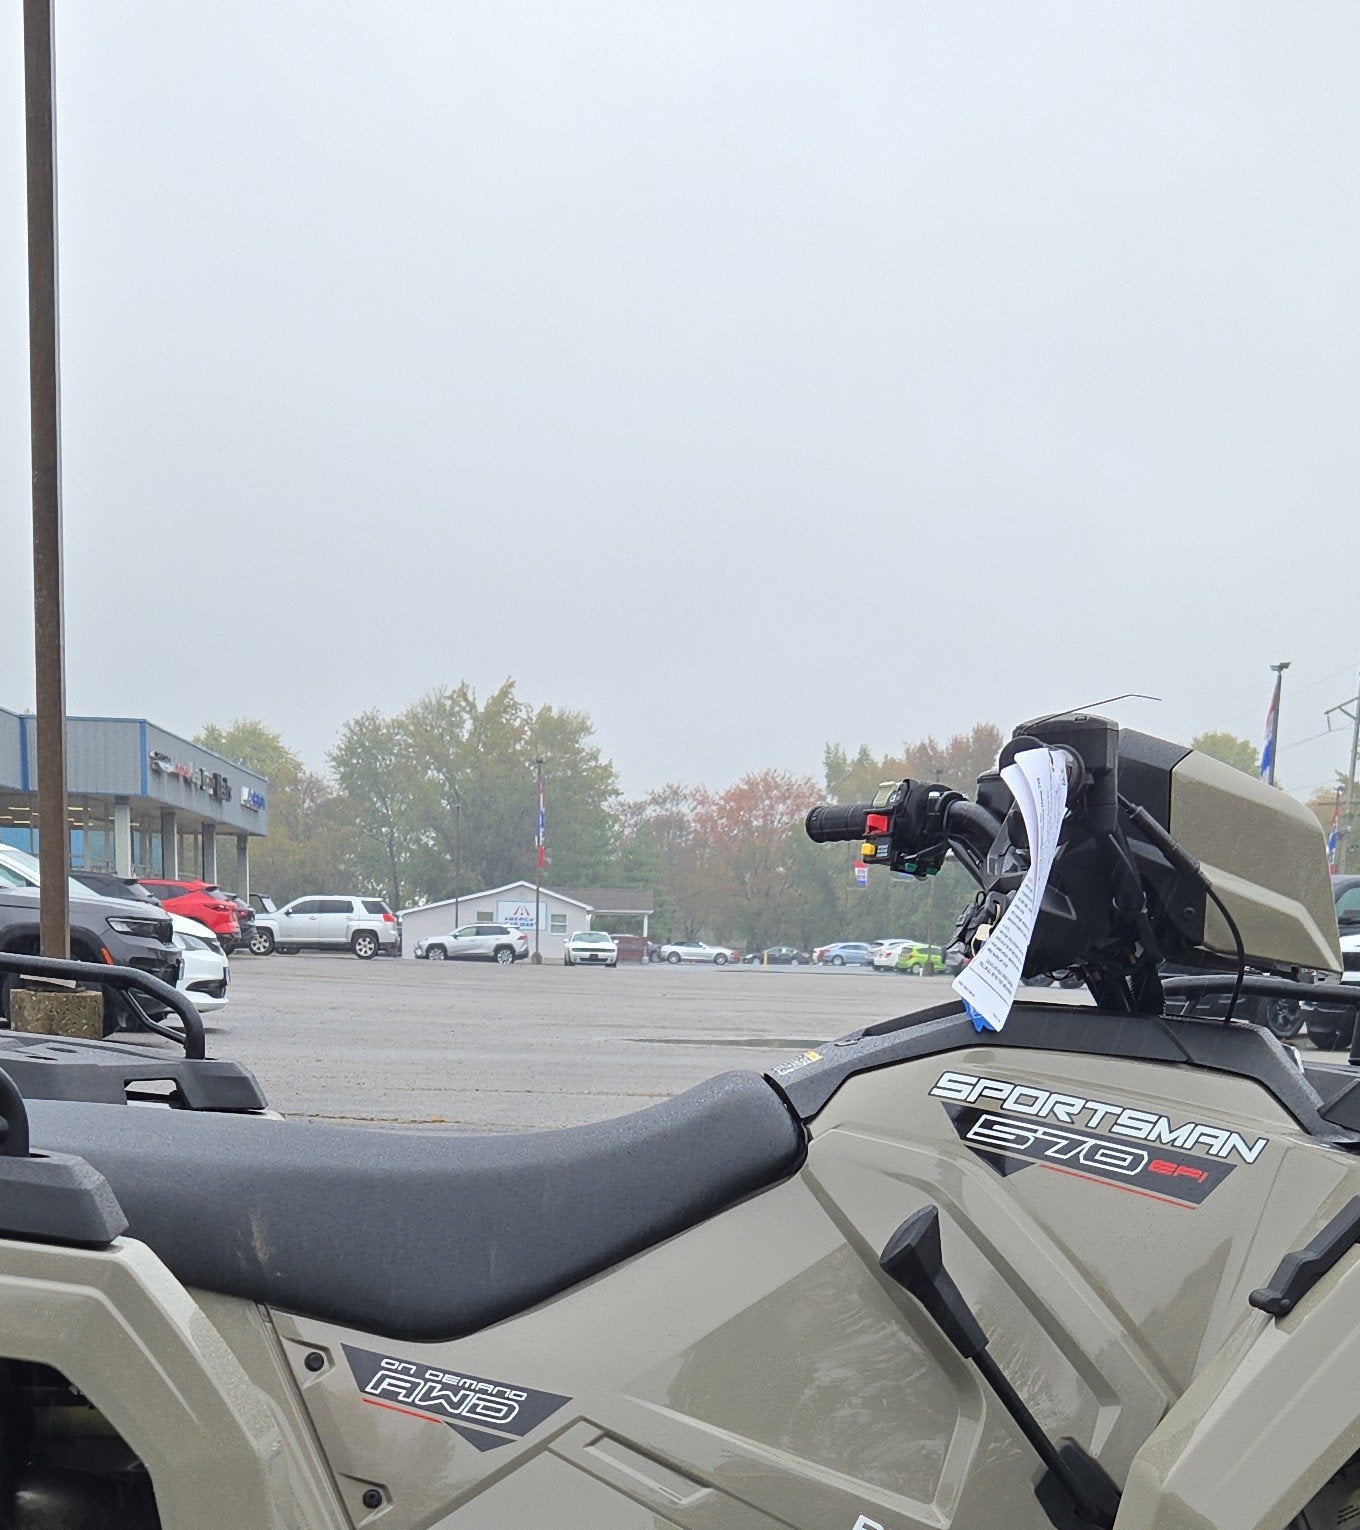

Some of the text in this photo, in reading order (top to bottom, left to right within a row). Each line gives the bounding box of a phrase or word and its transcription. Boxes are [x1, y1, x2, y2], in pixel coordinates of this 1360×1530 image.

[929, 1071, 1269, 1164] SPORTSMAN
[966, 1115, 1148, 1175] 570
[364, 1371, 519, 1424] AWD
[381, 1358, 527, 1401] ON DEMAND
